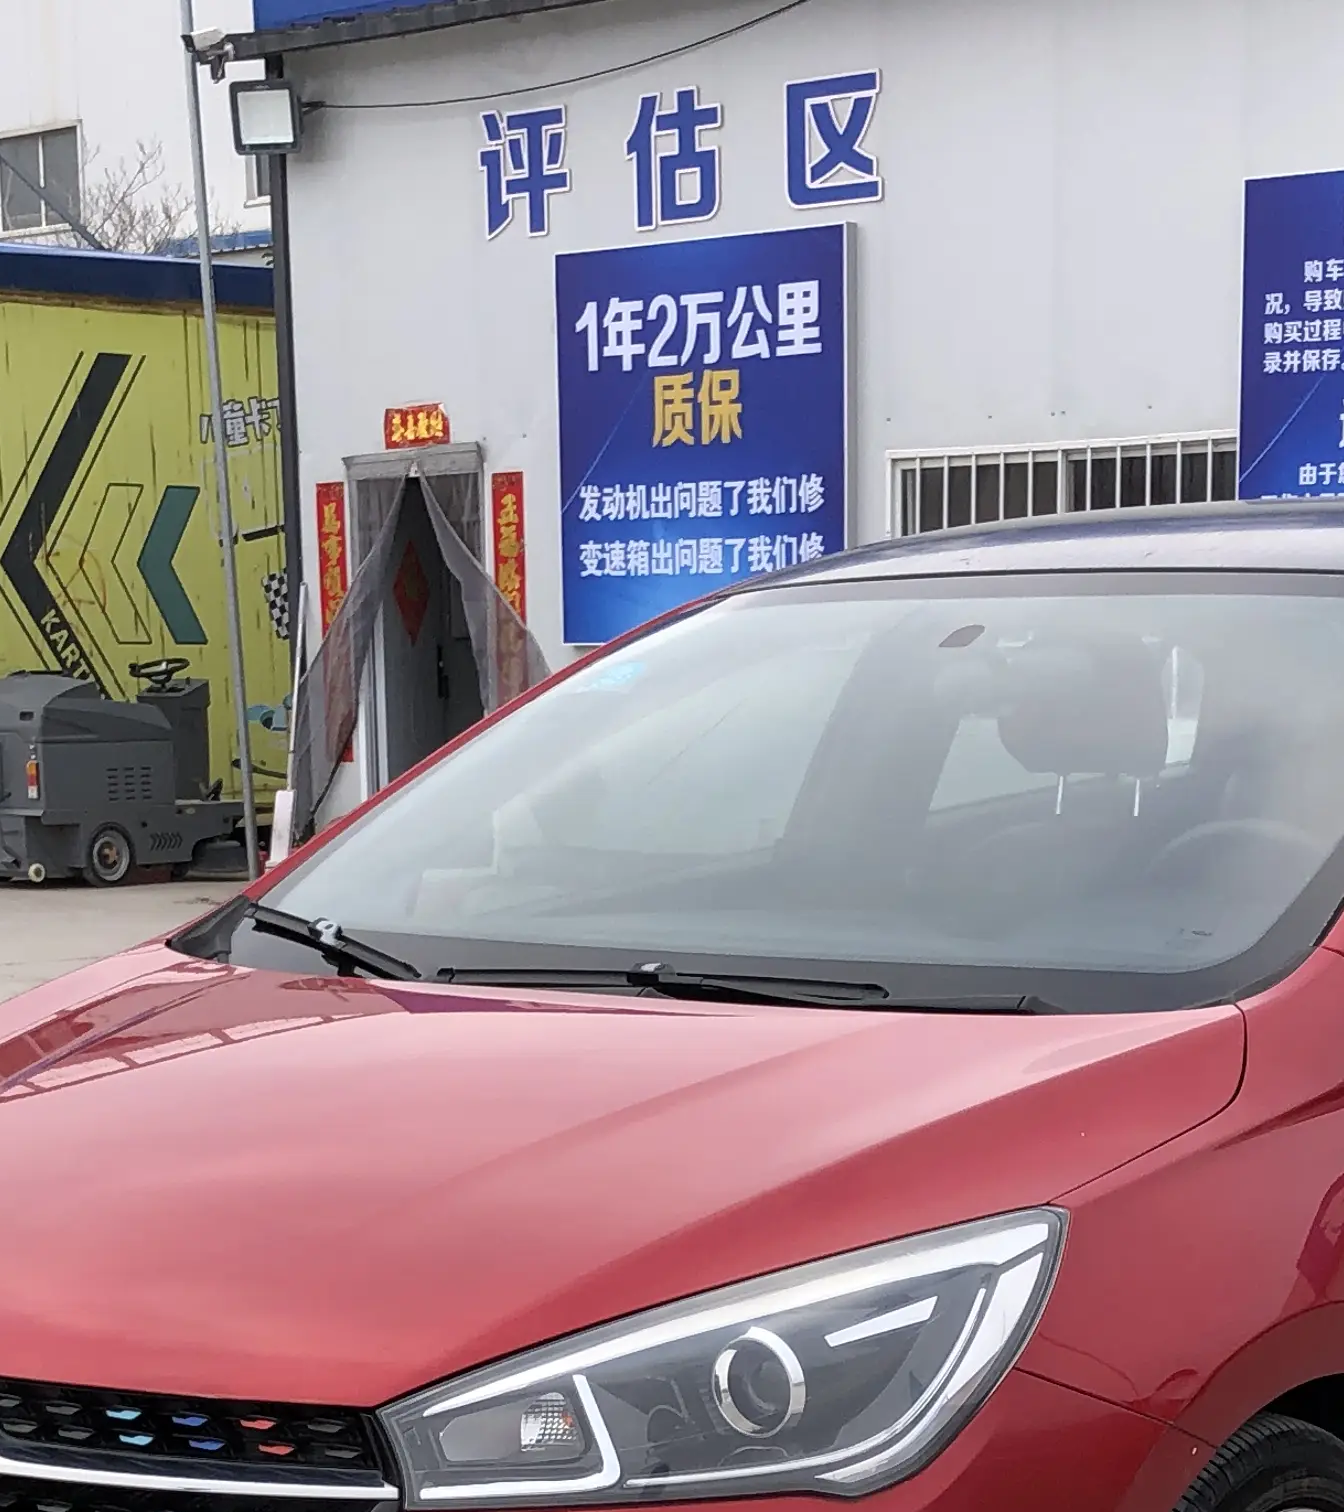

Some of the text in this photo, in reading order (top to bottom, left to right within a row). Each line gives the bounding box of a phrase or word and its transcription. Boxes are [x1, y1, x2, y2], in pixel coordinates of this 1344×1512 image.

[479, 69, 883, 239] 评估区
[574, 280, 823, 372] 1年2万公里
[651, 369, 743, 448] 质保
[578, 472, 826, 522] 发动机出问题了我们修
[578, 531, 826, 577] 变速箱出问题了我们修
[41, 608, 106, 700] KART
